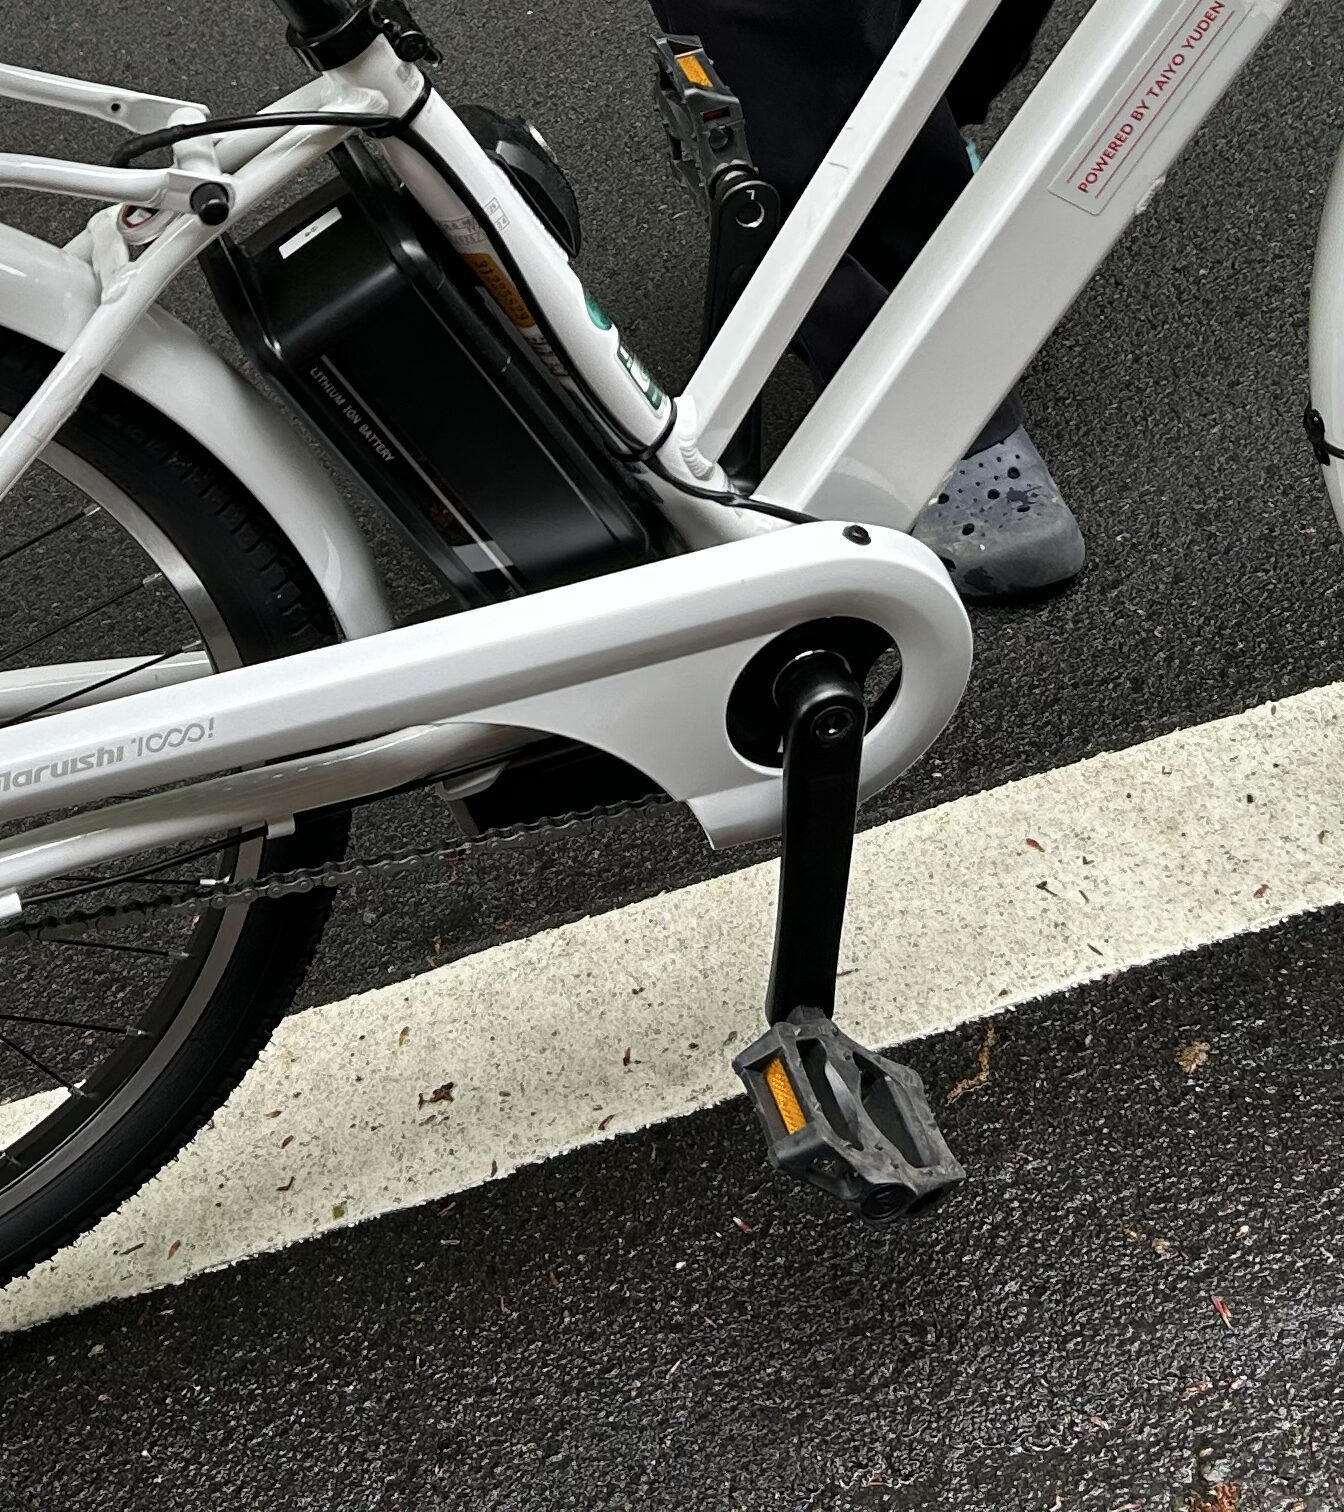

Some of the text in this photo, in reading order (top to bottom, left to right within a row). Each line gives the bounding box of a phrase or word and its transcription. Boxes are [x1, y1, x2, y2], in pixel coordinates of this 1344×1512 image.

[1077, 0, 1226, 194] POWERED BY TAIYO YUDEN
[310, 367, 395, 463] LITHIUM ION BATTERY
